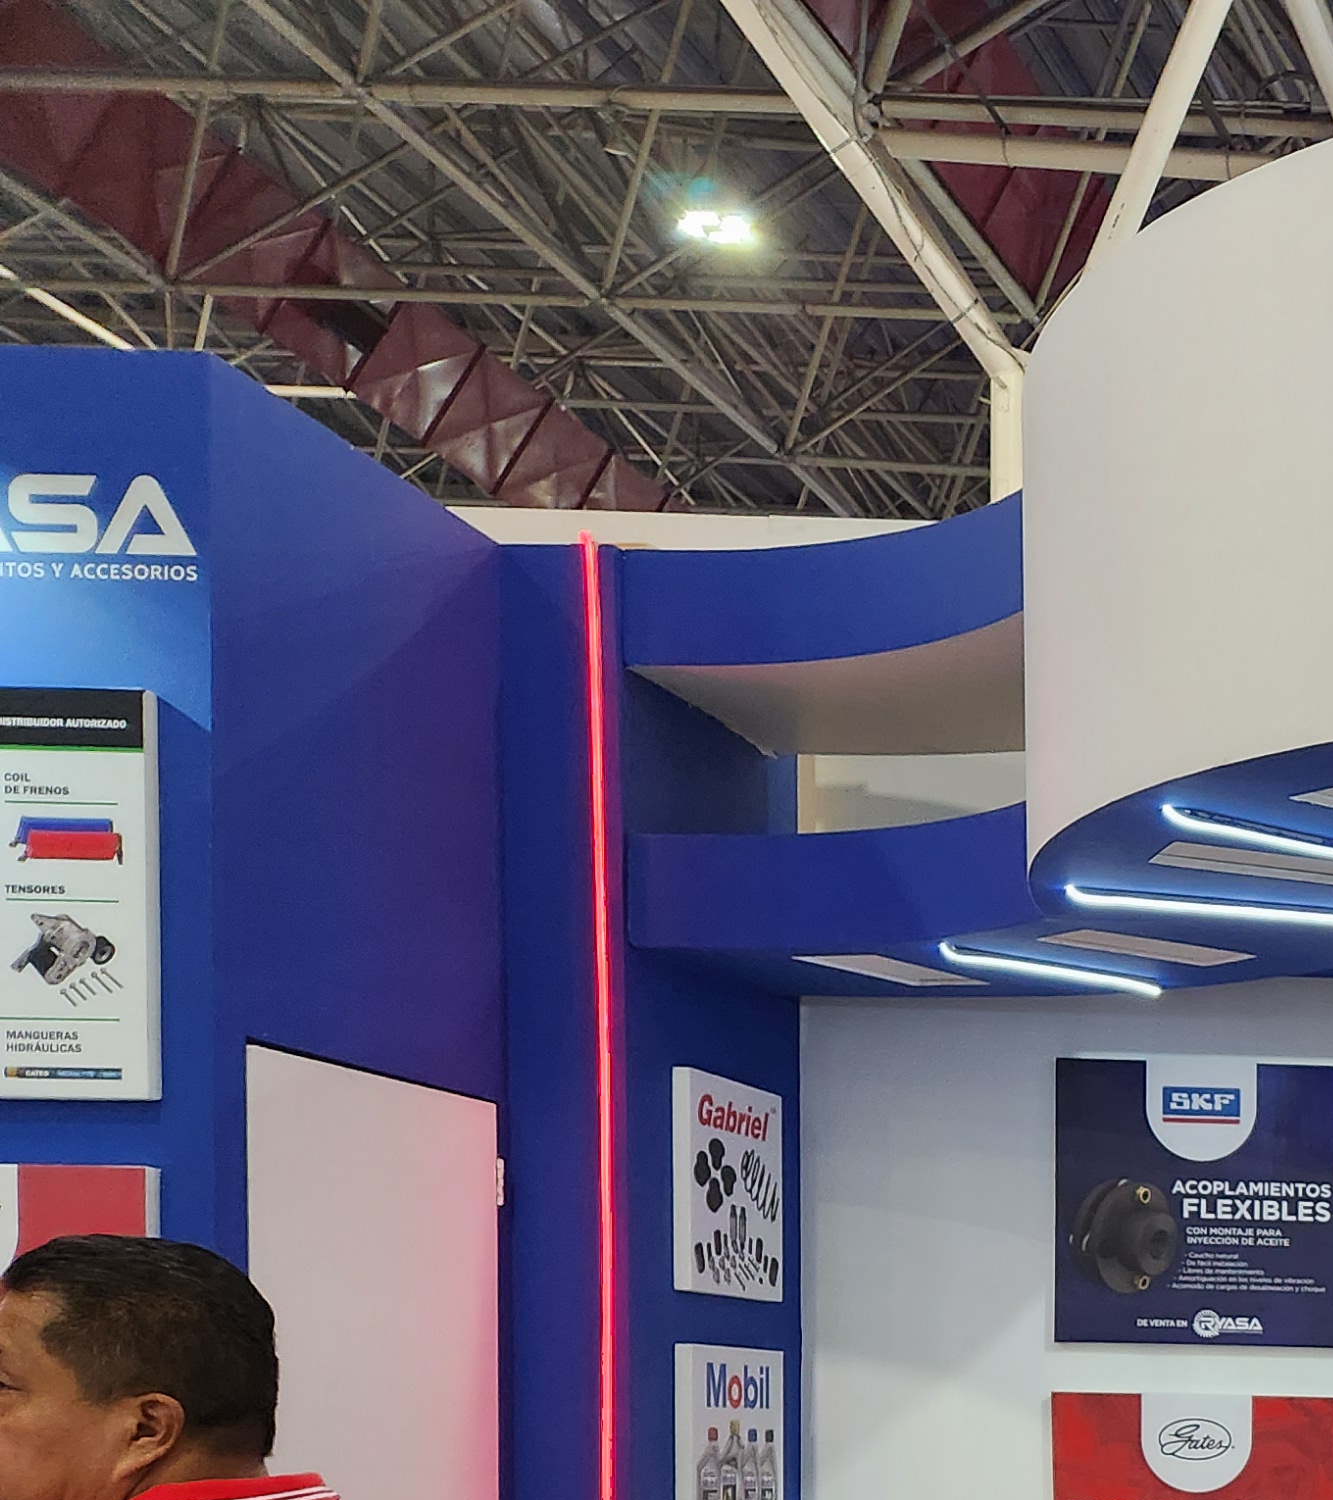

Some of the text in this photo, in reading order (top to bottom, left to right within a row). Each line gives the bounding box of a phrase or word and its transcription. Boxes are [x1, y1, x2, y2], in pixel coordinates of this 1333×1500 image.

[0, 473, 197, 556] SA
[0, 561, 198, 581] TOS Y ACCESORIOS
[66, 718, 127, 729] AUTORIZADO
[4, 773, 31, 782] COIL
[4, 786, 70, 795] DE FRENOS
[5, 884, 66, 895] TENSORES
[6, 1031, 79, 1040] MANGUERAS
[6, 1041, 82, 1053] HIDRÁULICAS
[1169, 1093, 1235, 1111] SKF
[698, 1094, 769, 1141] Gabriel
[1172, 1180, 1332, 1198] ACOPLAMIENTOS
[1182, 1199, 1331, 1222] FLEXIBLES
[1186, 1226, 1282, 1237] CON MONTAJE PARA
[1187, 1235, 1290, 1247] INYECCIÓN DE ACEITE
[1150, 1316, 1263, 1337] VENTA RYASA
[706, 1362, 769, 1409] Mobil
[1162, 1424, 1228, 1455] Gates
